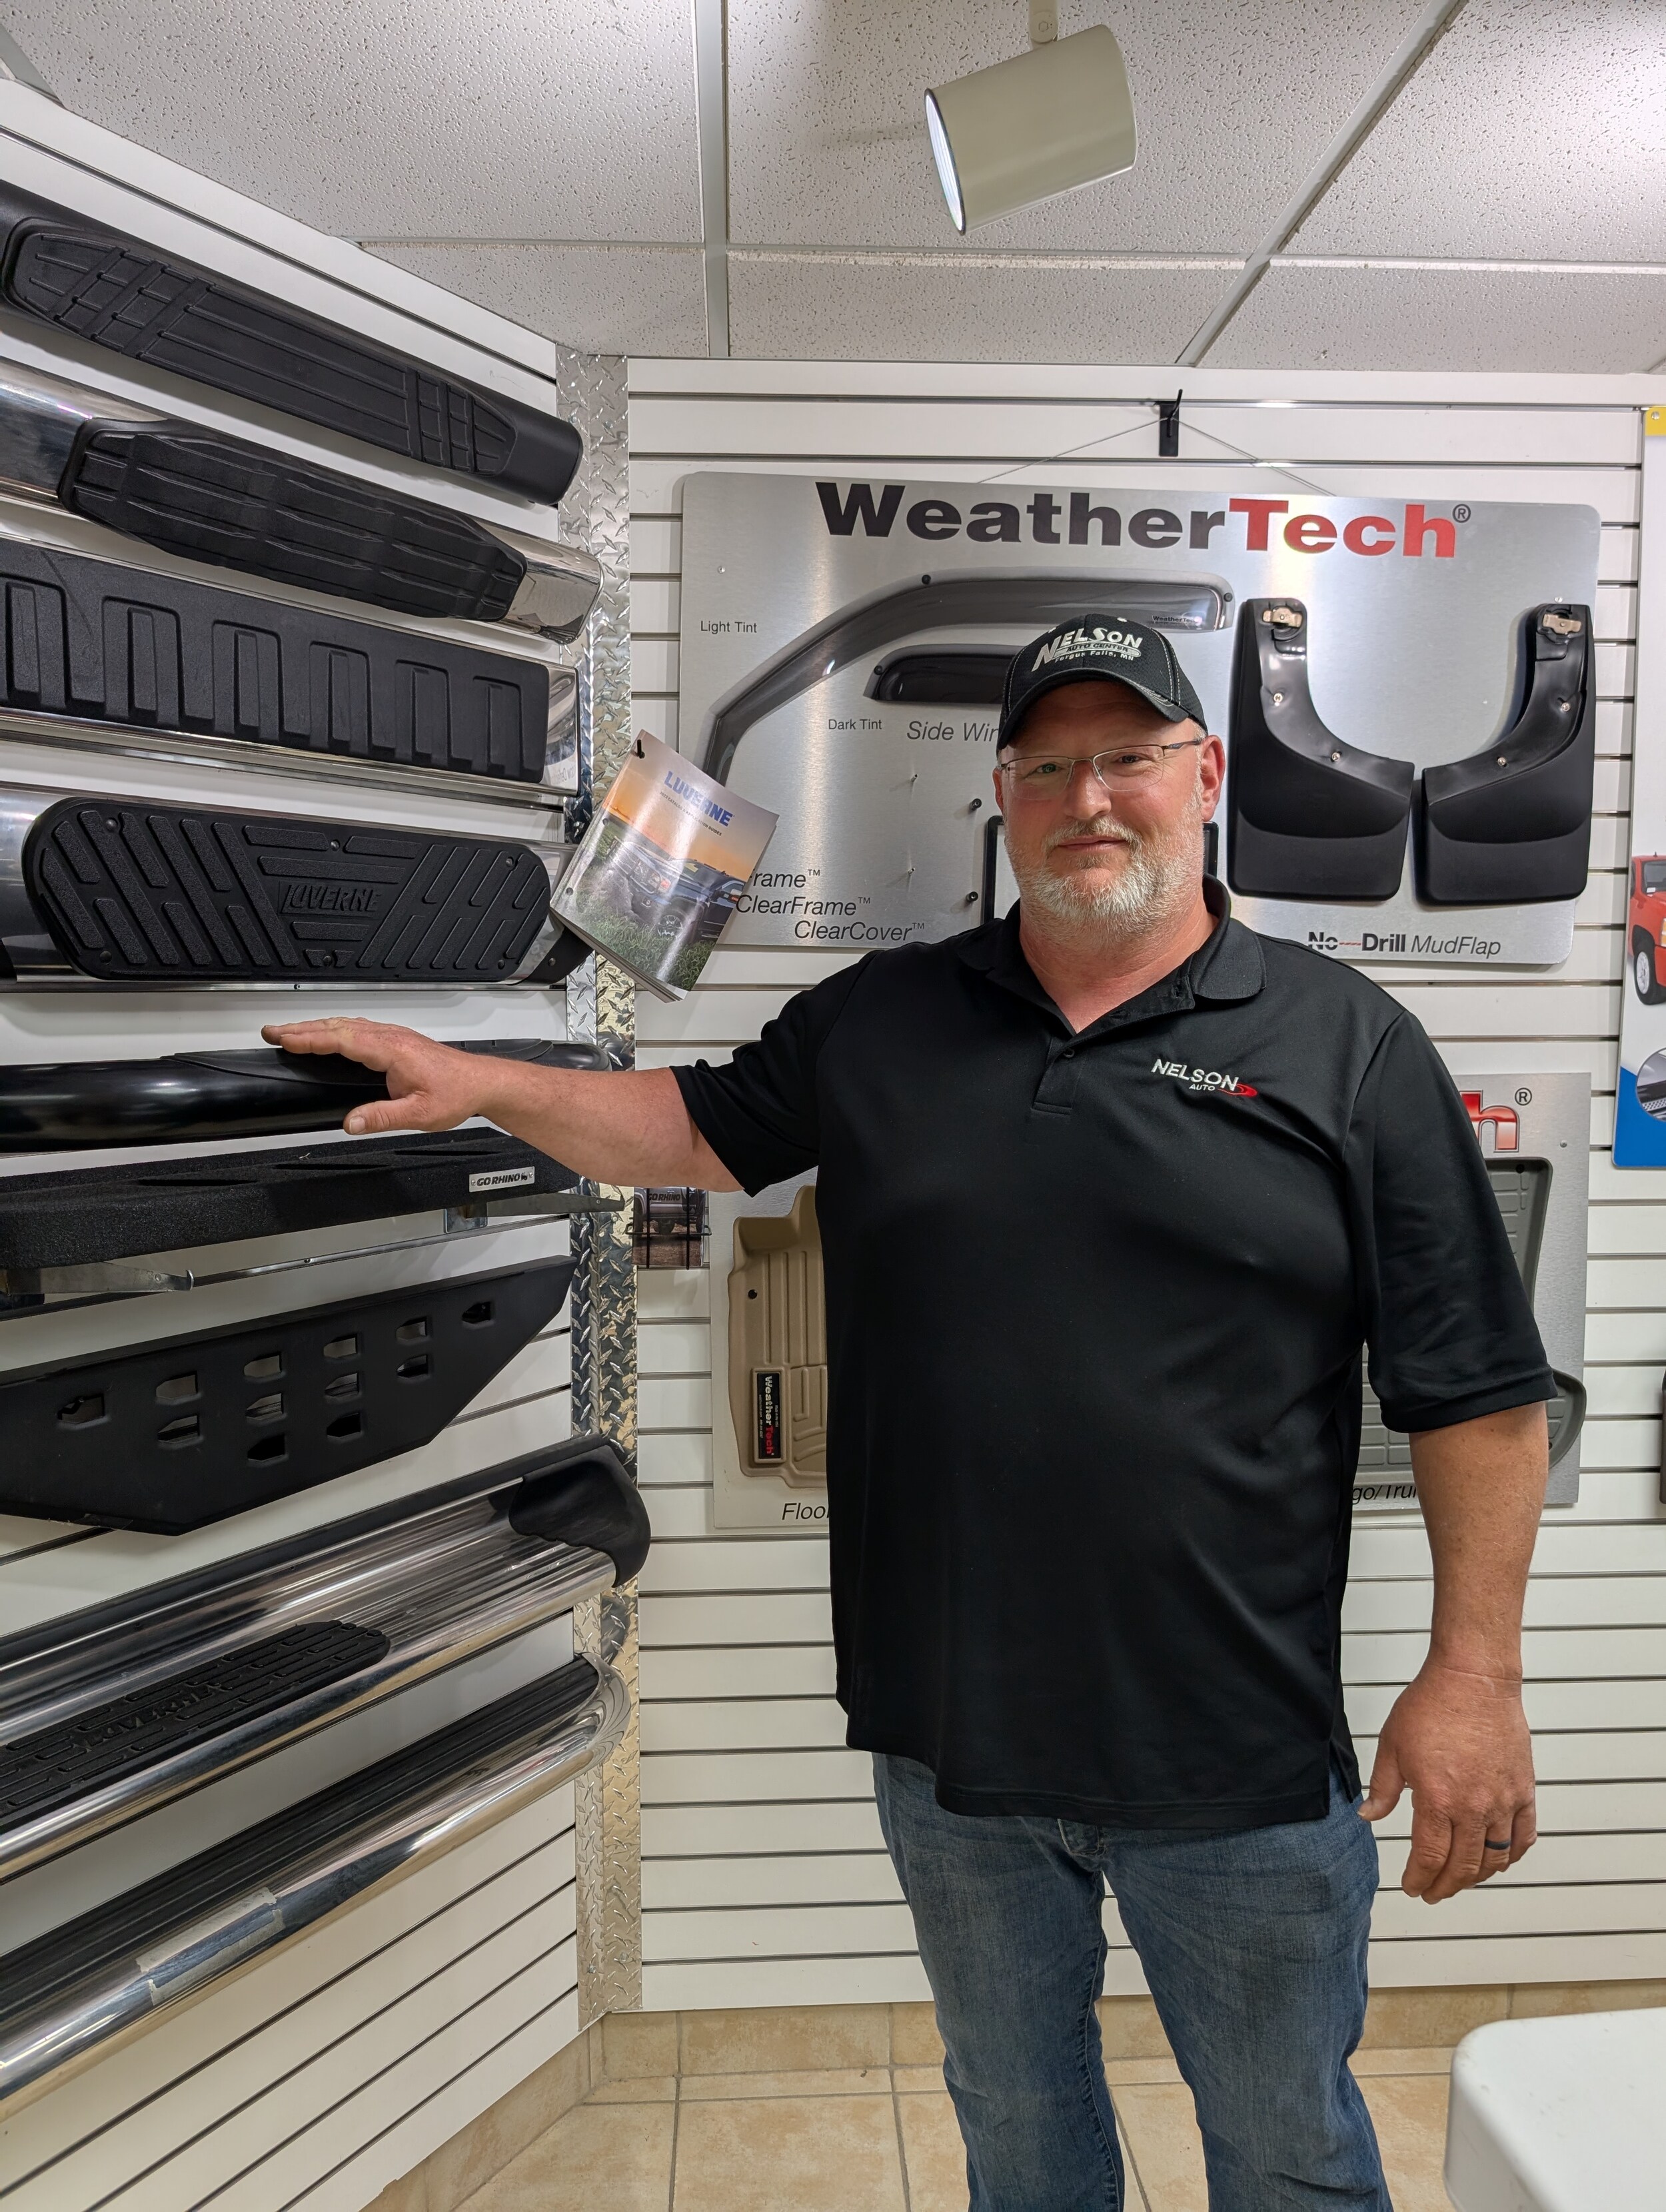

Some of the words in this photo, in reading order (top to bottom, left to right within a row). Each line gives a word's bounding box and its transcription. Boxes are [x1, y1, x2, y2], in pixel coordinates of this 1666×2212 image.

[700, 621, 730, 634] Light
[734, 622, 757, 633] Tint
[1031, 627, 1143, 672] NELSON
[1066, 643, 1091, 652] AUTO
[1093, 642, 1128, 652] CENTER
[1055, 652, 1086, 664] Fergus
[1120, 653, 1134, 662] MN
[828, 719, 856, 730] Dark
[860, 720, 882, 730] Tint
[906, 720, 954, 741] Side
[664, 772, 733, 827] LUVERNE
[708, 826, 722, 837] GUIDES
[280, 884, 383, 916] LUVERNE
[1411, 935, 1501, 959] MudFlap
[1151, 1058, 1240, 1091] NELSON
[782, 1502, 829, 1520] Floo
